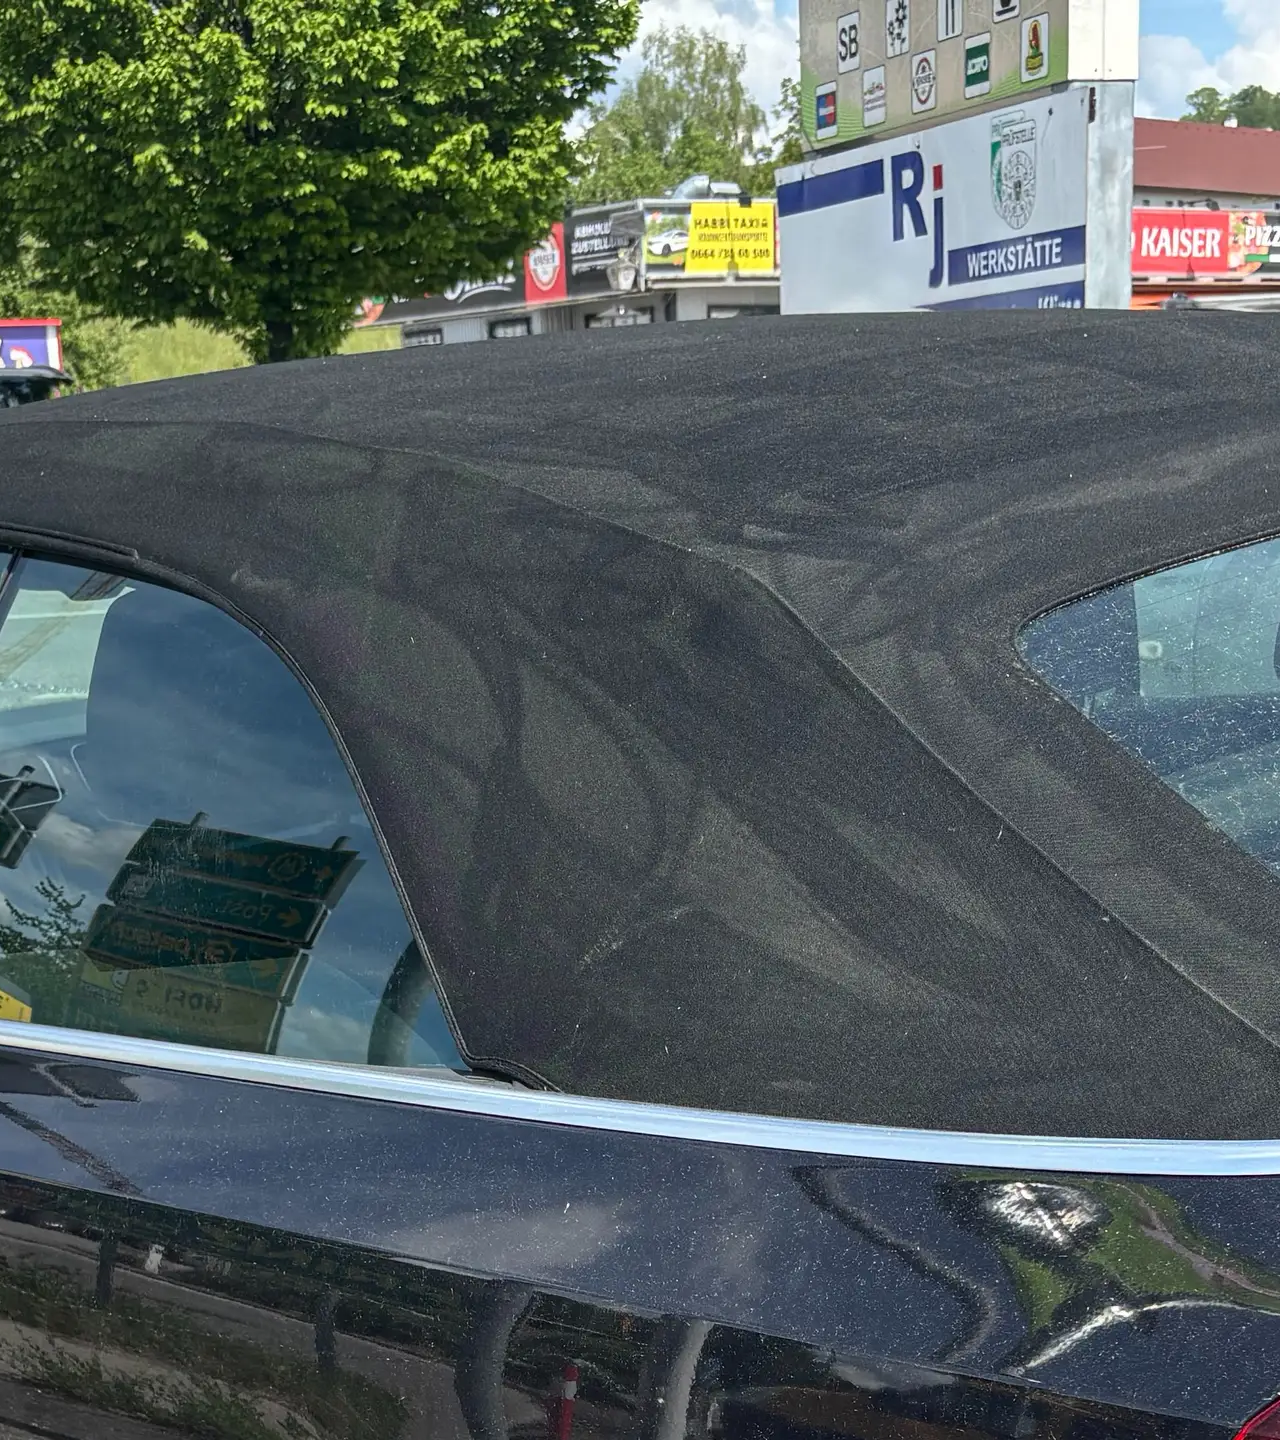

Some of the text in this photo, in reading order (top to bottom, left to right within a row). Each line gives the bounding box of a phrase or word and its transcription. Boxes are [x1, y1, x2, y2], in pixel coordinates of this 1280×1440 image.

[838, 23, 859, 62] SB
[967, 236, 1063, 278] WERKSTÄTTE
[1140, 226, 1222, 260] KAISER
